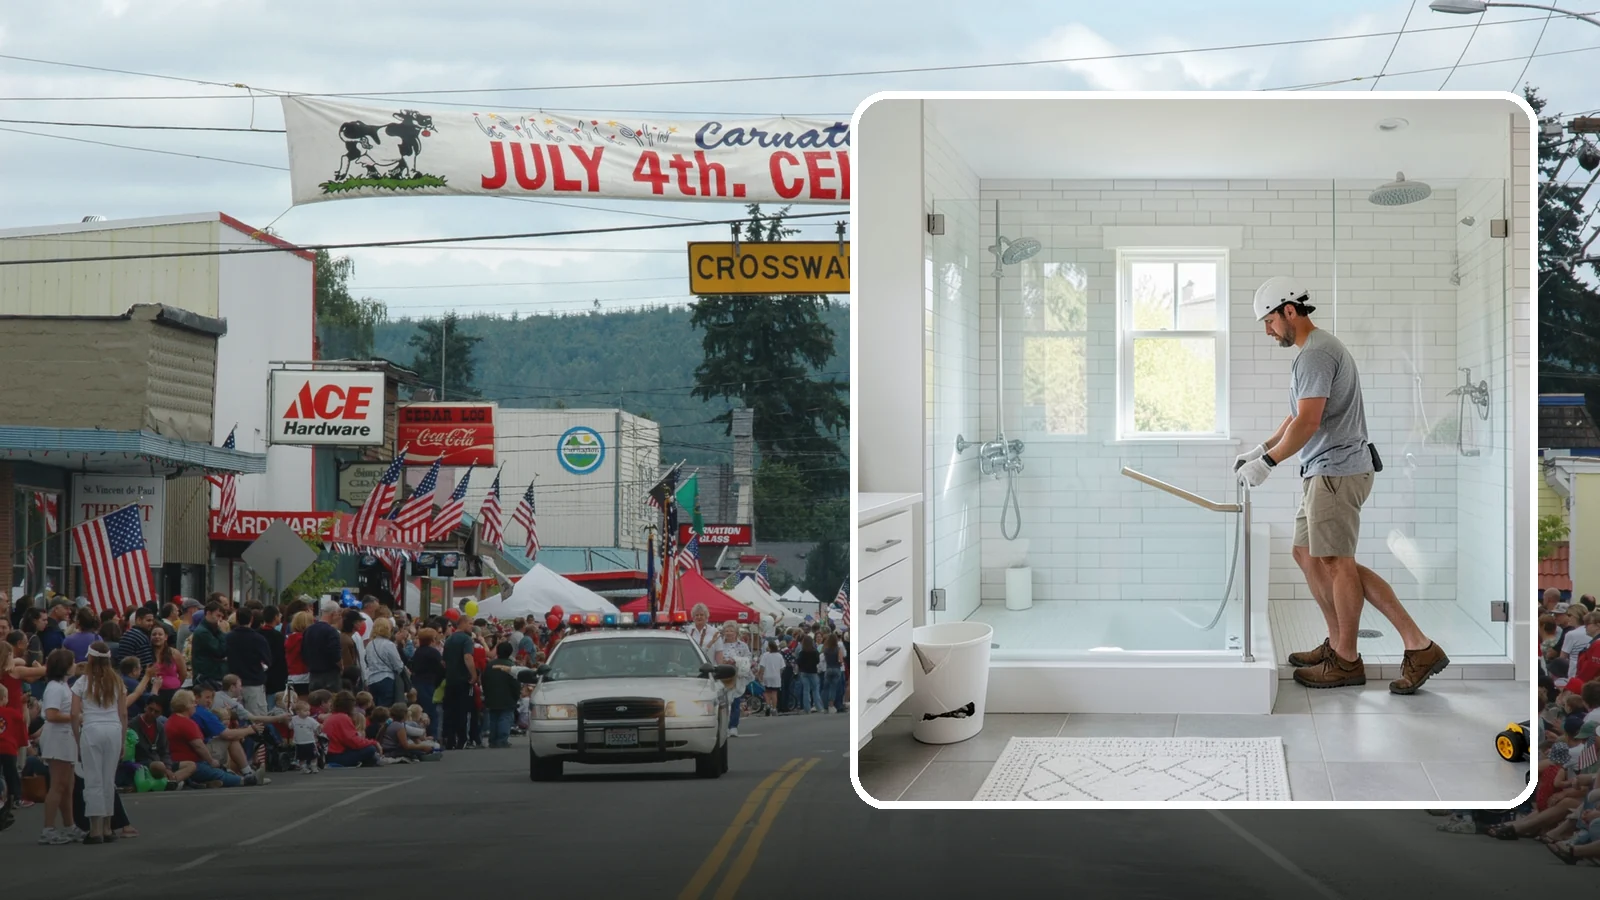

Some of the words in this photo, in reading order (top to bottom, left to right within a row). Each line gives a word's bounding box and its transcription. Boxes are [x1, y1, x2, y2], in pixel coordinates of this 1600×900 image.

[481, 141, 604, 193] JULY
[632, 150, 746, 197] 4th.
[697, 254, 850, 280] CROSSWA
[283, 380, 373, 420] ACE
[405, 409, 452, 421] CEDAR
[462, 410, 485, 421] LOG
[283, 421, 371, 437] Hardware
[416, 428, 476, 447] Coca-Cola
[354, 467, 387, 483] Simpl
[83, 485, 93, 494] St.
[96, 485, 124, 494] Vincent
[126, 485, 136, 495] de
[137, 486, 155, 495] Paul
[688, 526, 741, 535] CRNATION
[699, 535, 730, 543] GLASS
